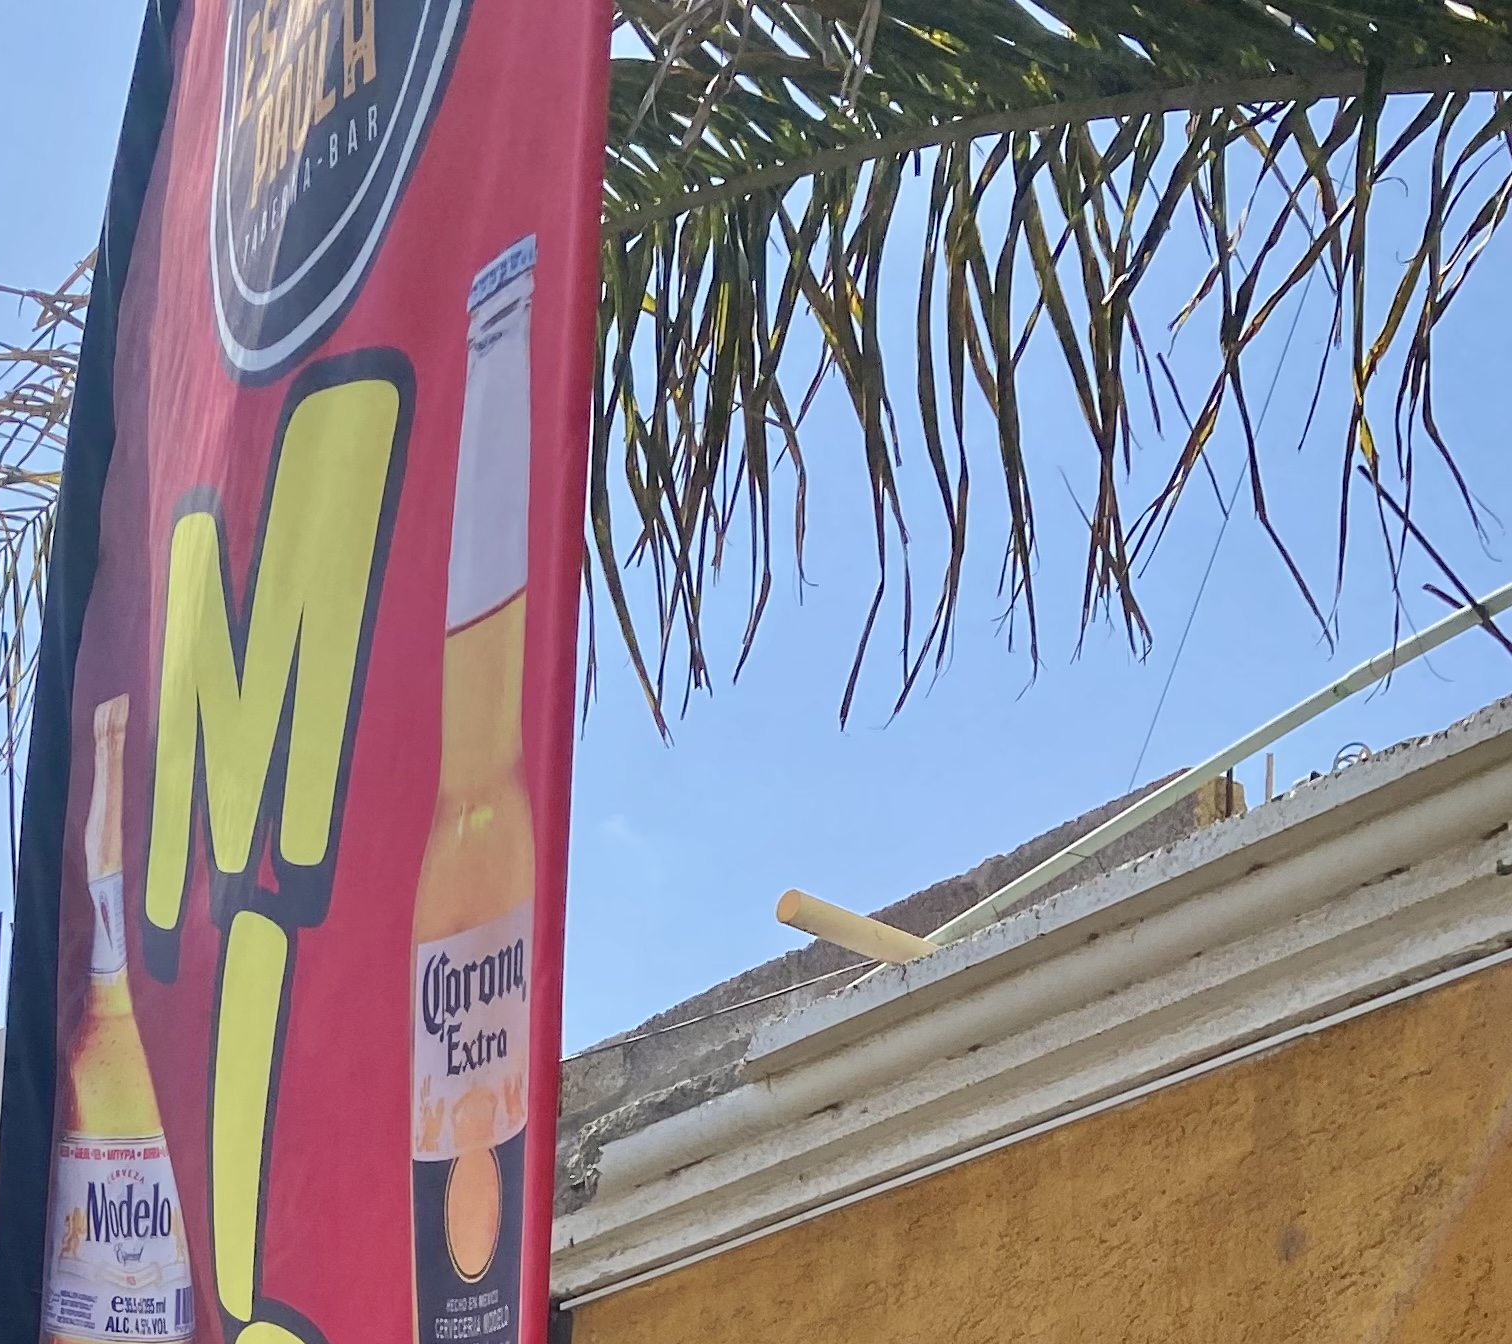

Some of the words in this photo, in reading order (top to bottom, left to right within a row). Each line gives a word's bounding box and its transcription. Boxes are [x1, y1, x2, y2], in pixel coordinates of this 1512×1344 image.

[422, 936, 526, 1043] Corona
[445, 1022, 508, 1079] Extra
[107, 1168, 146, 1185] CERVEZA
[85, 1181, 172, 1243] Modelo
